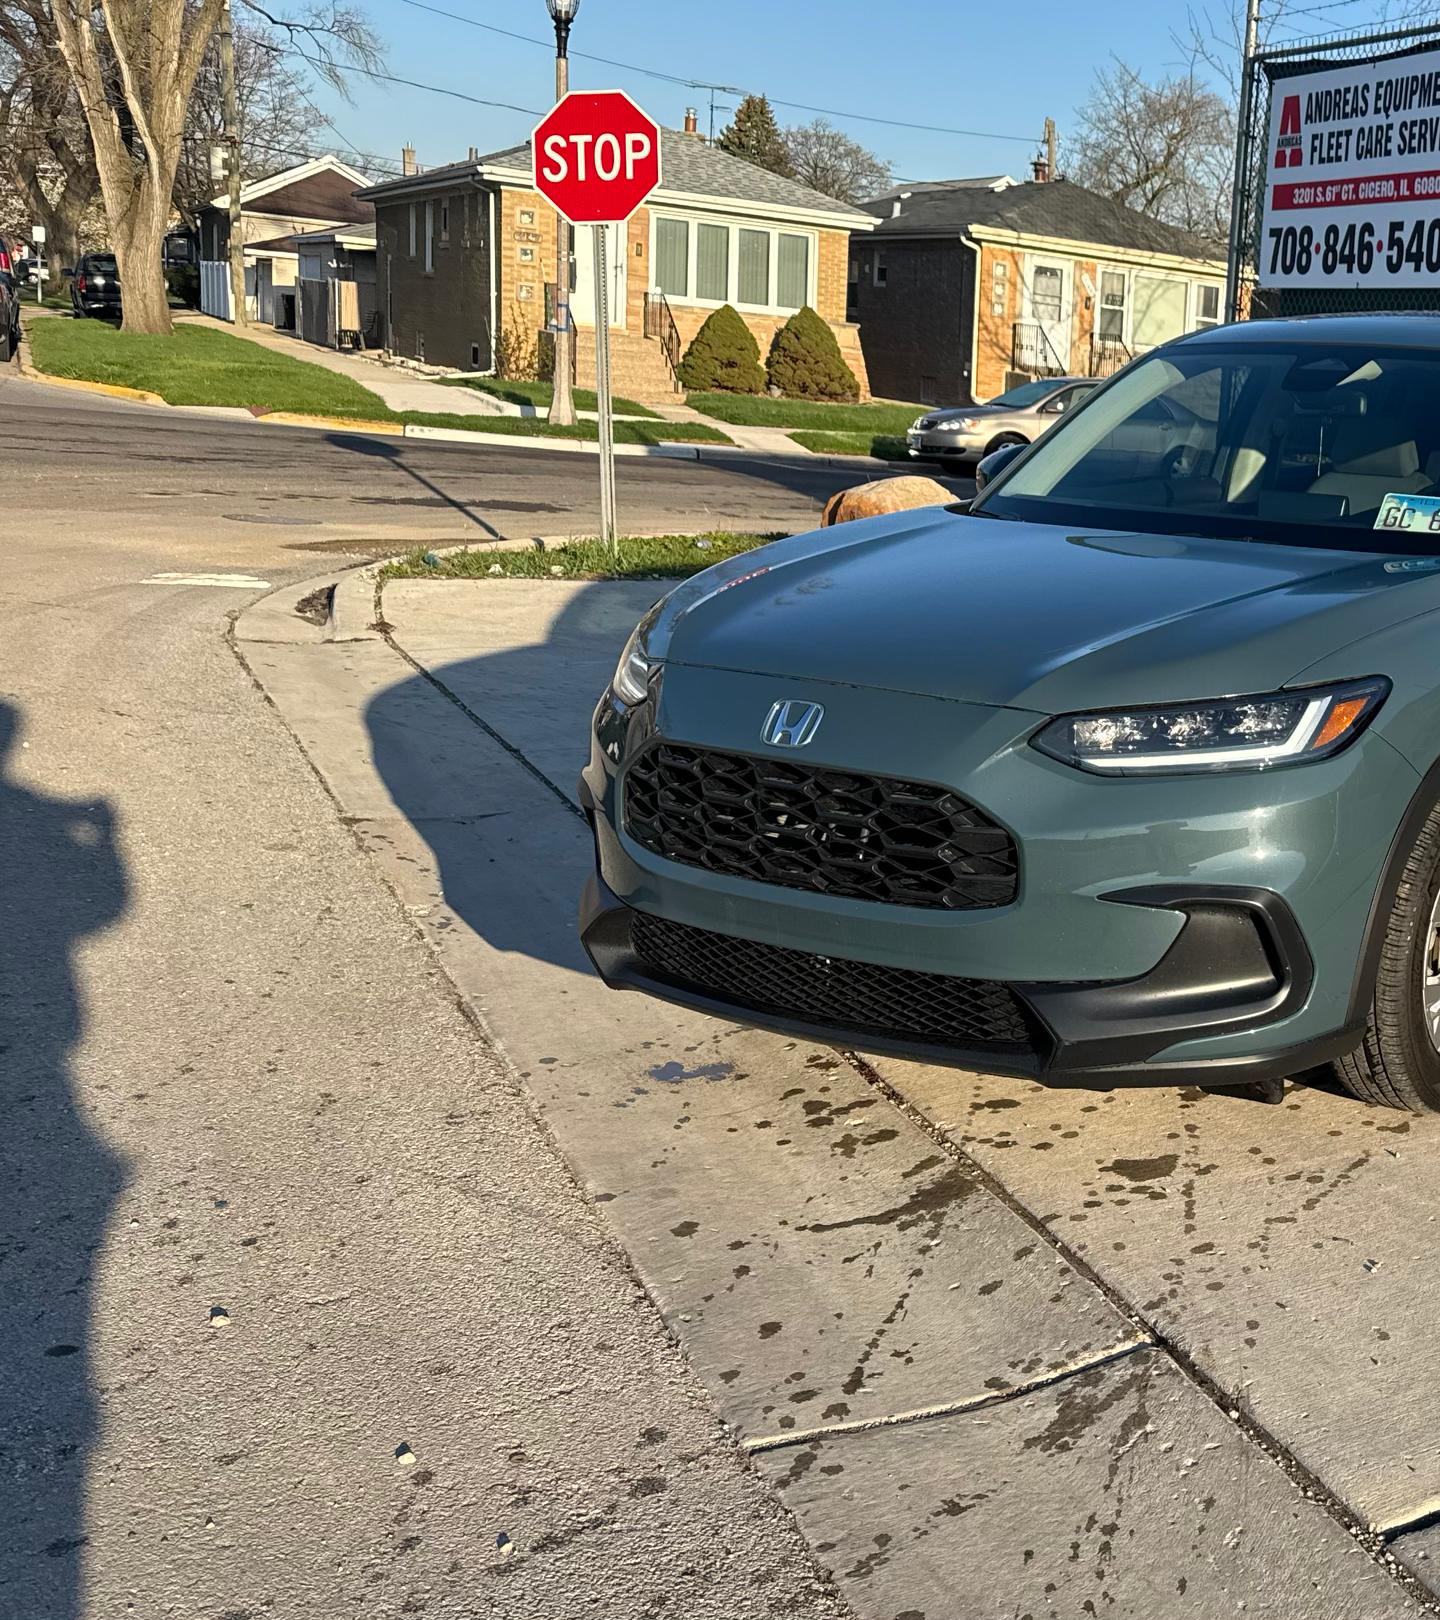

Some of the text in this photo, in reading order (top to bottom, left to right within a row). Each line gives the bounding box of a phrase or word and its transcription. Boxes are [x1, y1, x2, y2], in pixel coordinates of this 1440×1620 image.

[1304, 83, 1370, 125] ANDREAS
[542, 133, 651, 183] STOP
[1310, 128, 1353, 166] FLEET
[1356, 122, 1394, 161] CARE
[1293, 187, 1315, 205] 3201
[1341, 184, 1356, 200] CT.
[1358, 181, 1397, 200] CICERO,
[1400, 179, 1410, 196] IL
[1383, 506, 1416, 529] GC
